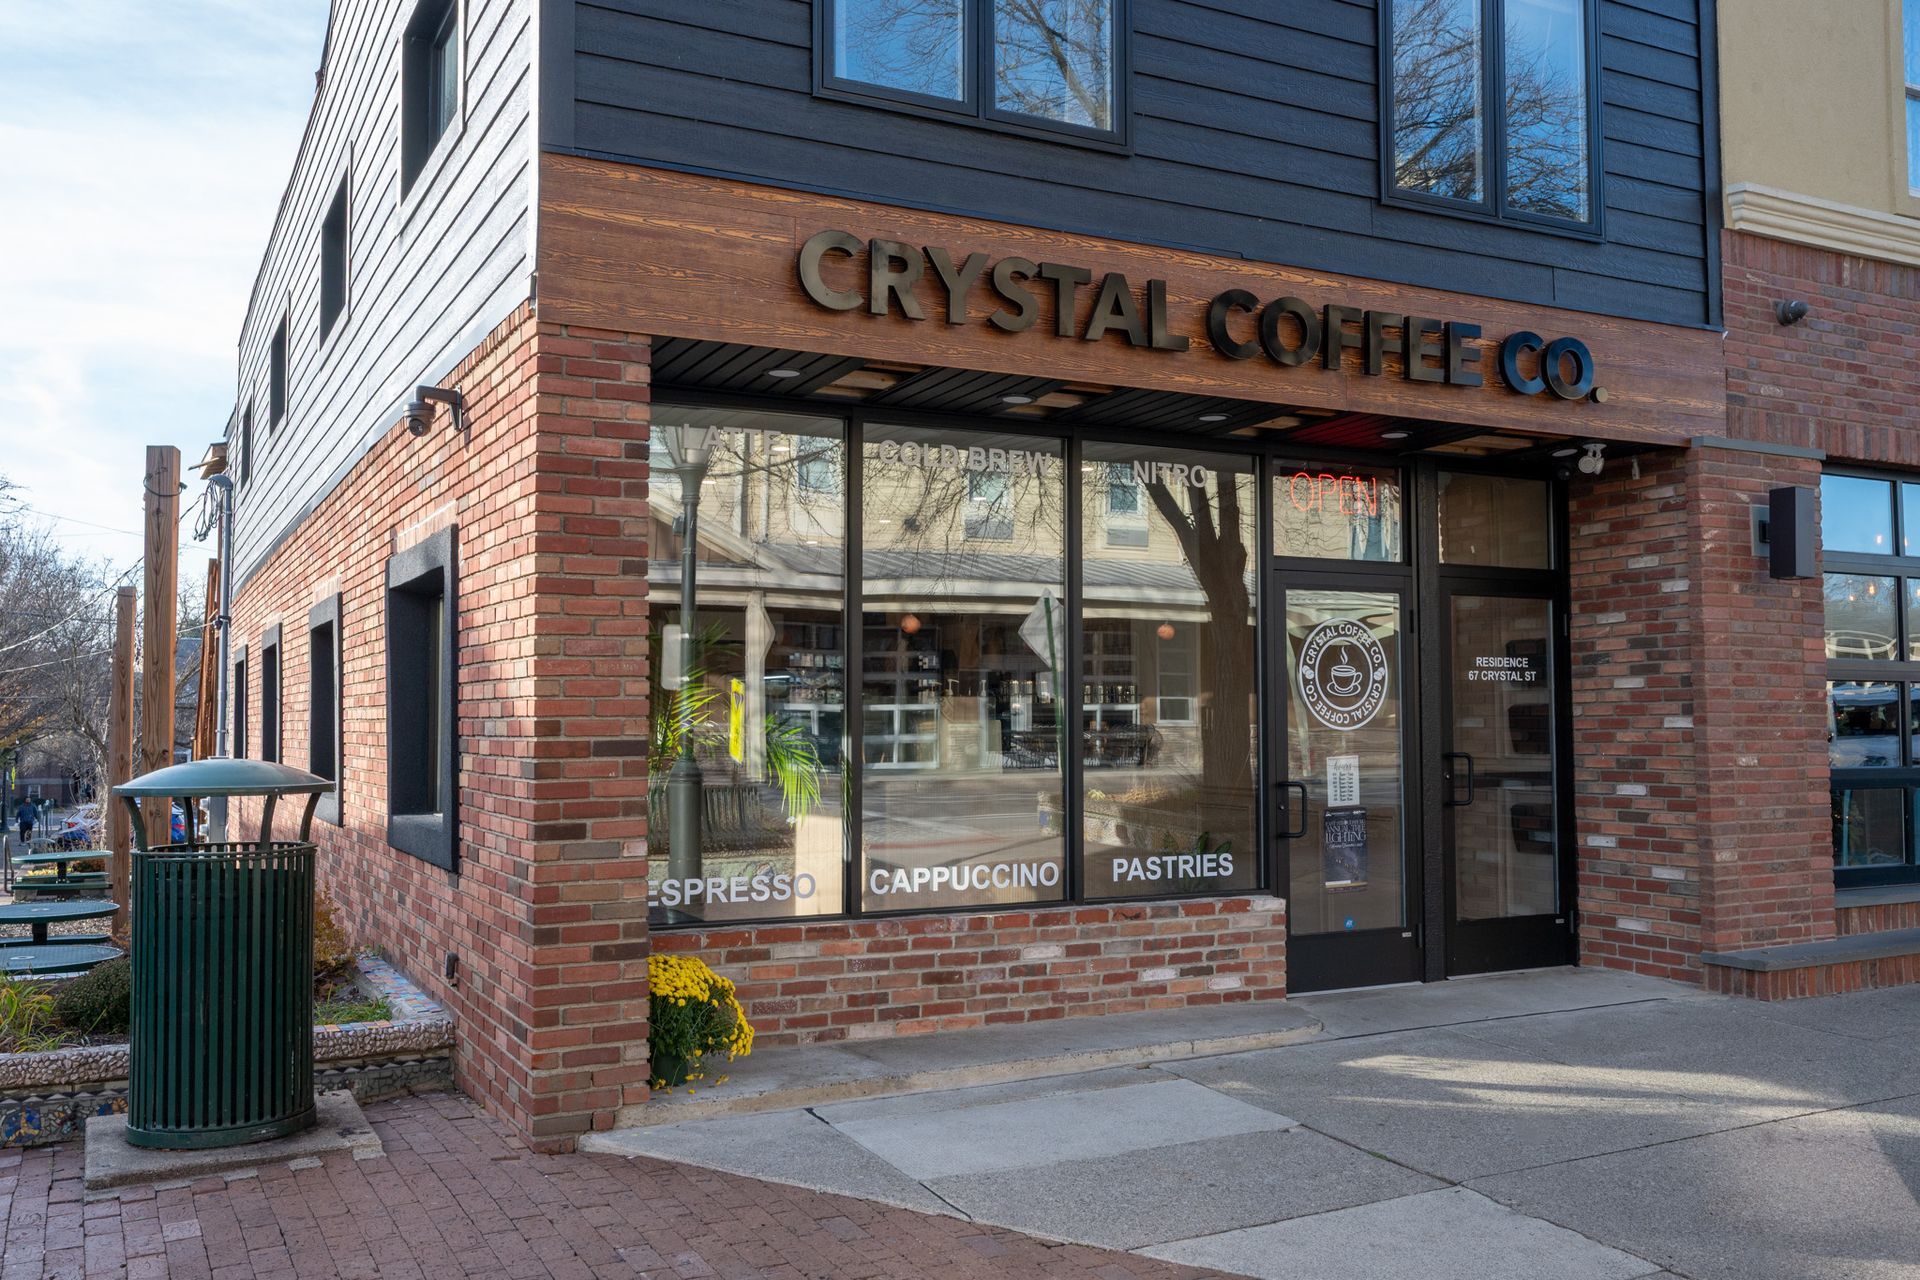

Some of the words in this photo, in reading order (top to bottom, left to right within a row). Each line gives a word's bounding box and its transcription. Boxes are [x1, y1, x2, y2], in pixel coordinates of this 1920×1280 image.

[799, 229, 1190, 352] CRYSTAL
[1206, 288, 1483, 387] COFFEE
[1499, 330, 1609, 403] CO.
[683, 423, 783, 457] LATTE
[879, 439, 959, 468] COLD
[968, 446, 1052, 477] BREW
[1132, 459, 1209, 489] NITRO
[1290, 472, 1377, 517] OPEN
[1305, 626, 1338, 665] CRYSTAL
[1338, 624, 1373, 648] COFFEE
[1370, 646, 1382, 667] CO.
[1475, 656, 1529, 668] RESIDENCE
[1468, 670, 1479, 681] 67
[1481, 670, 1523, 681] CRYSTAL
[1524, 671, 1537, 681] ST
[1314, 700, 1350, 724] COFFEE
[1350, 682, 1382, 721] CRYSTAL
[869, 861, 1060, 895] CAPPUCCINO
[1111, 852, 1235, 883] PASTRIES
[647, 872, 817, 907] ESPRESSO
